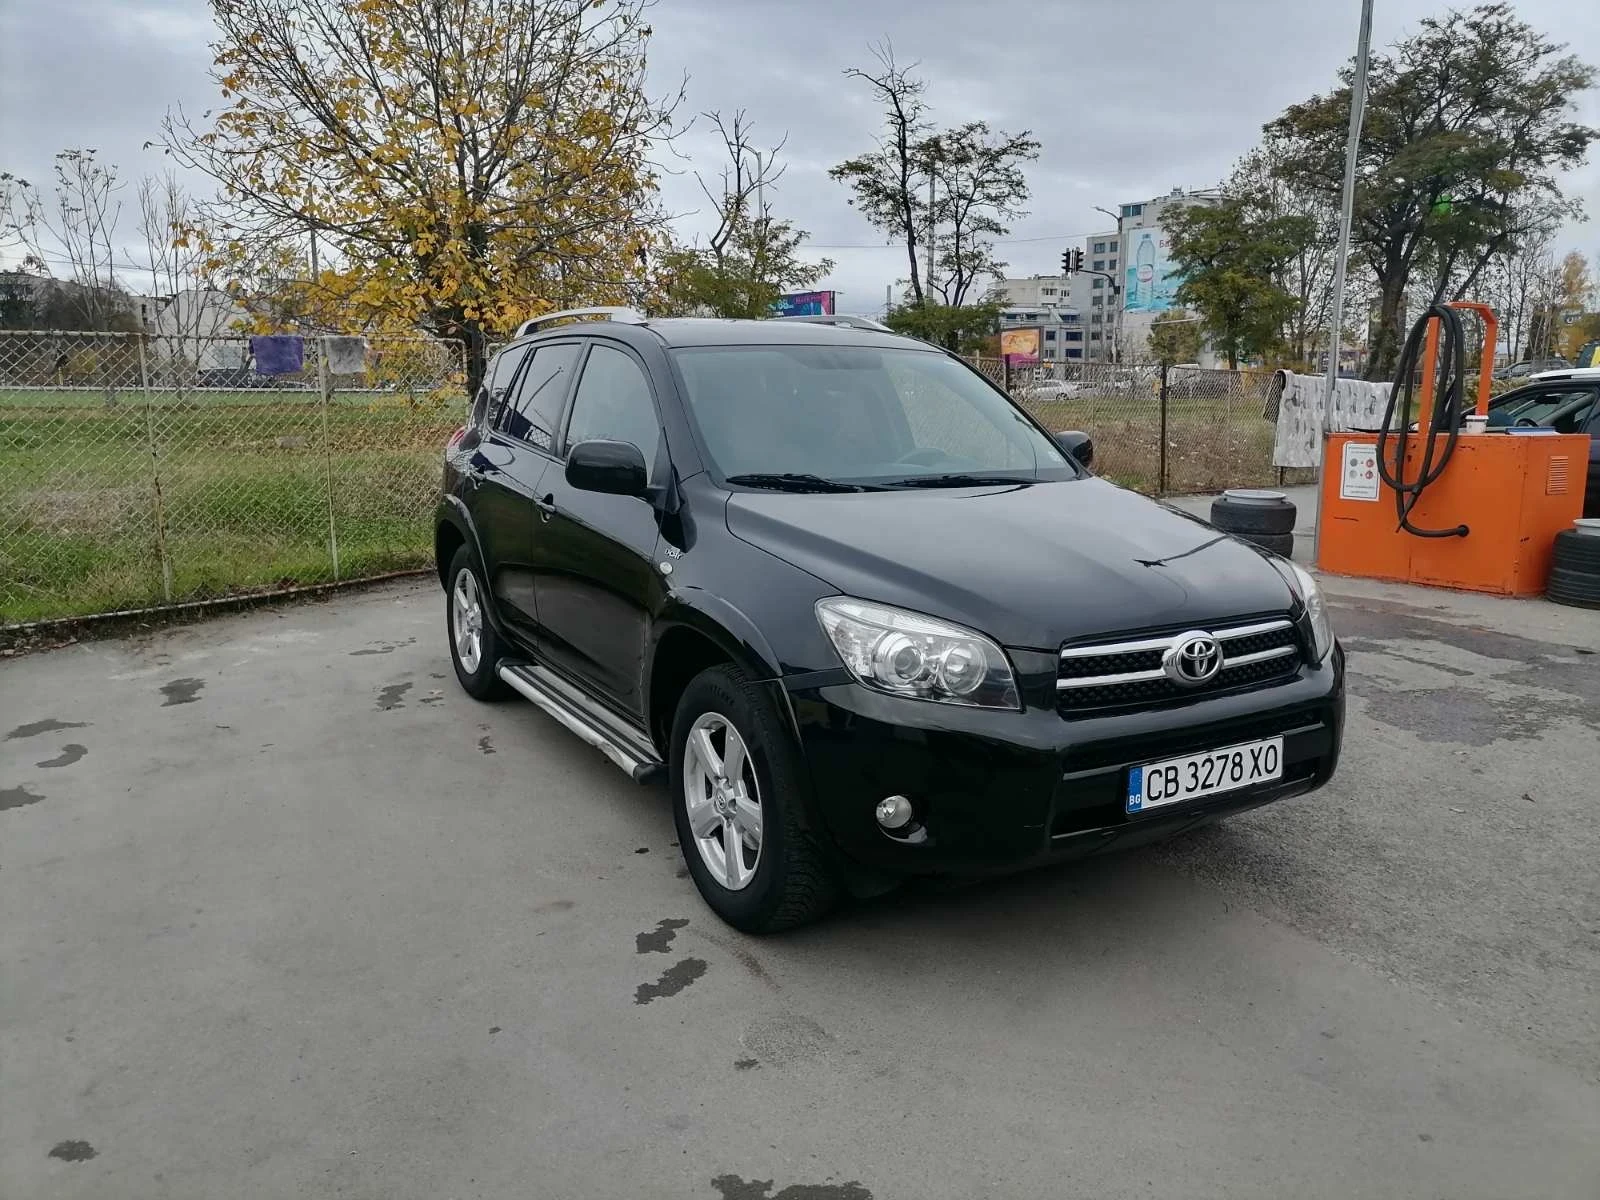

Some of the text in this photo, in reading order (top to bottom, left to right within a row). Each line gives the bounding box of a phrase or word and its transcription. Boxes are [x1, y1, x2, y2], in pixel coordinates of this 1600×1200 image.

[1146, 744, 1279, 802] CB 3278 XO
[1128, 793, 1142, 806] BG
